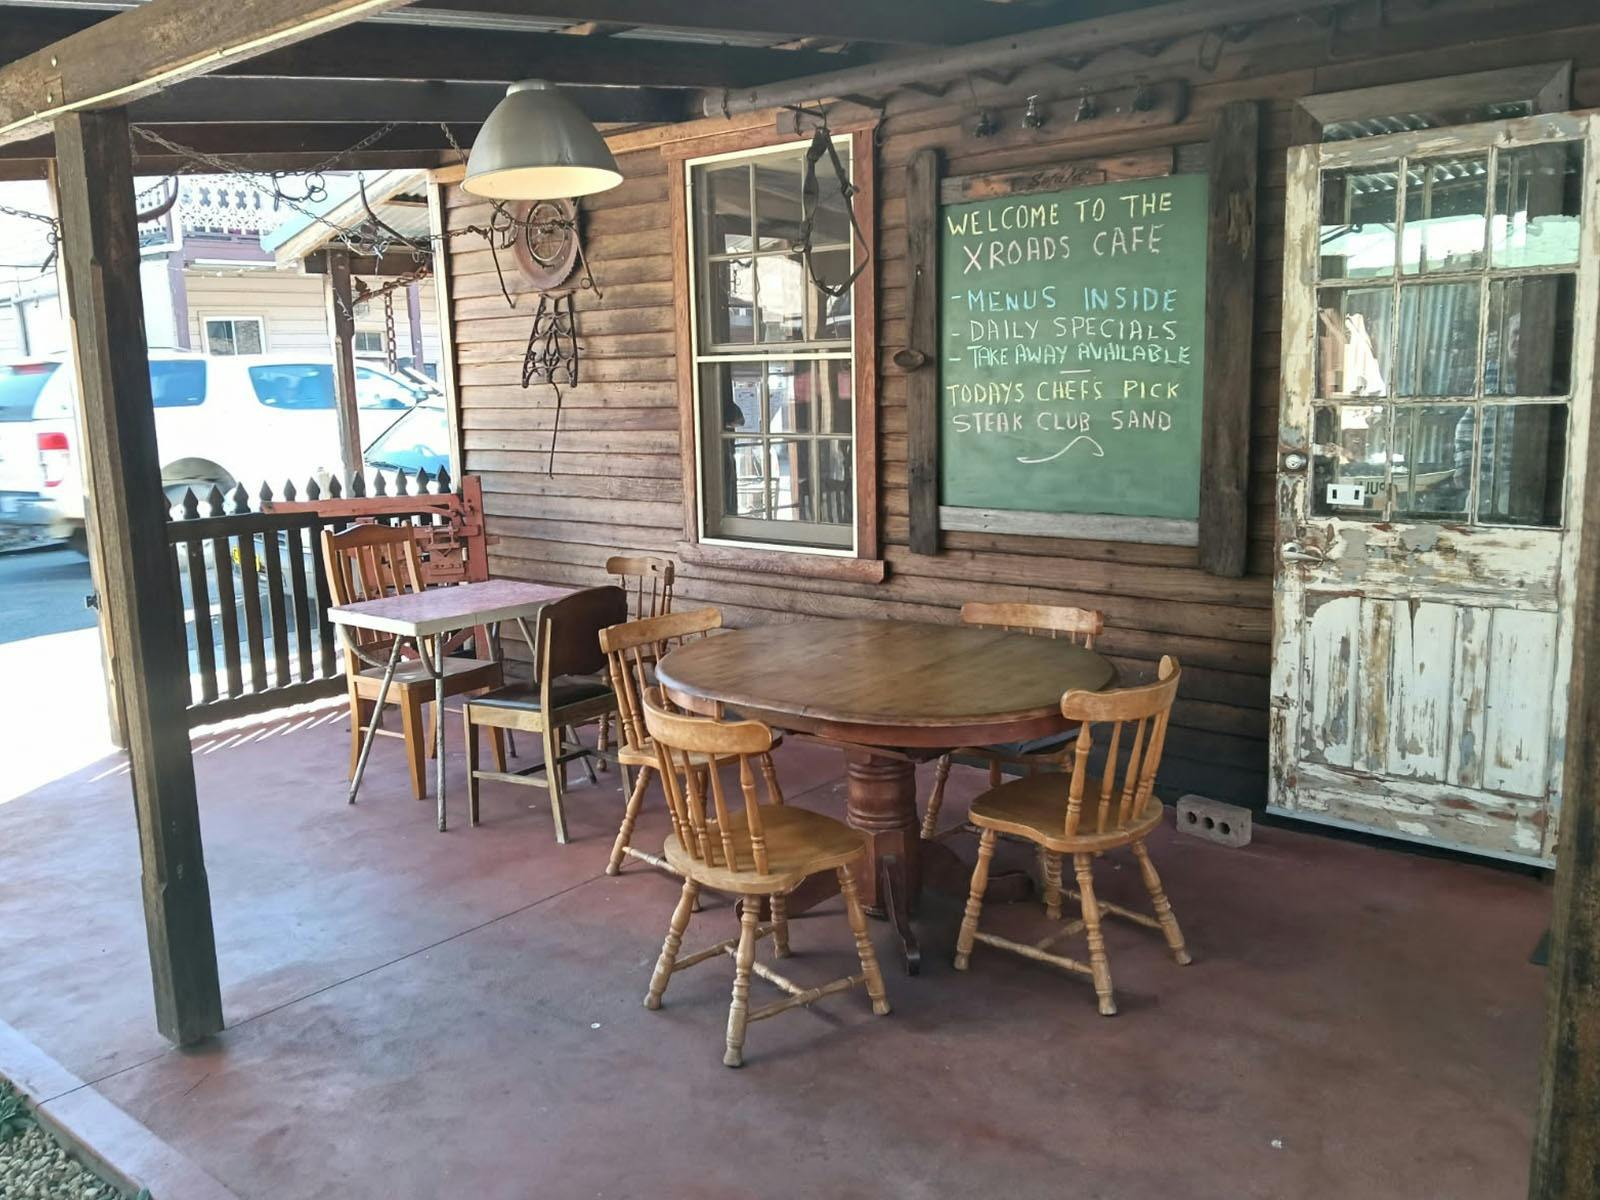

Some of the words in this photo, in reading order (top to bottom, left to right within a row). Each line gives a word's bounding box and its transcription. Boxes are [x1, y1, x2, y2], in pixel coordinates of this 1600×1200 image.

[947, 203, 1060, 236] WELCOME
[1074, 198, 1106, 223] TO
[1119, 192, 1173, 218] THE
[963, 235, 1071, 275] XROADS
[1093, 223, 1166, 257] CAFE
[967, 286, 1057, 312] MENUS
[1084, 287, 1178, 312] INSIDE
[970, 319, 1039, 342] DAILY
[1053, 316, 1178, 340] SPECIALS
[967, 345, 1010, 369] TAKE
[1015, 343, 1068, 365] AWAY
[1078, 341, 1193, 365] AVAILABLE
[946, 381, 1026, 407] TODAYS
[1123, 379, 1181, 400] PICK
[952, 412, 1023, 435] STEAK
[1036, 411, 1092, 432] CLUB
[1111, 409, 1173, 432] SAND
